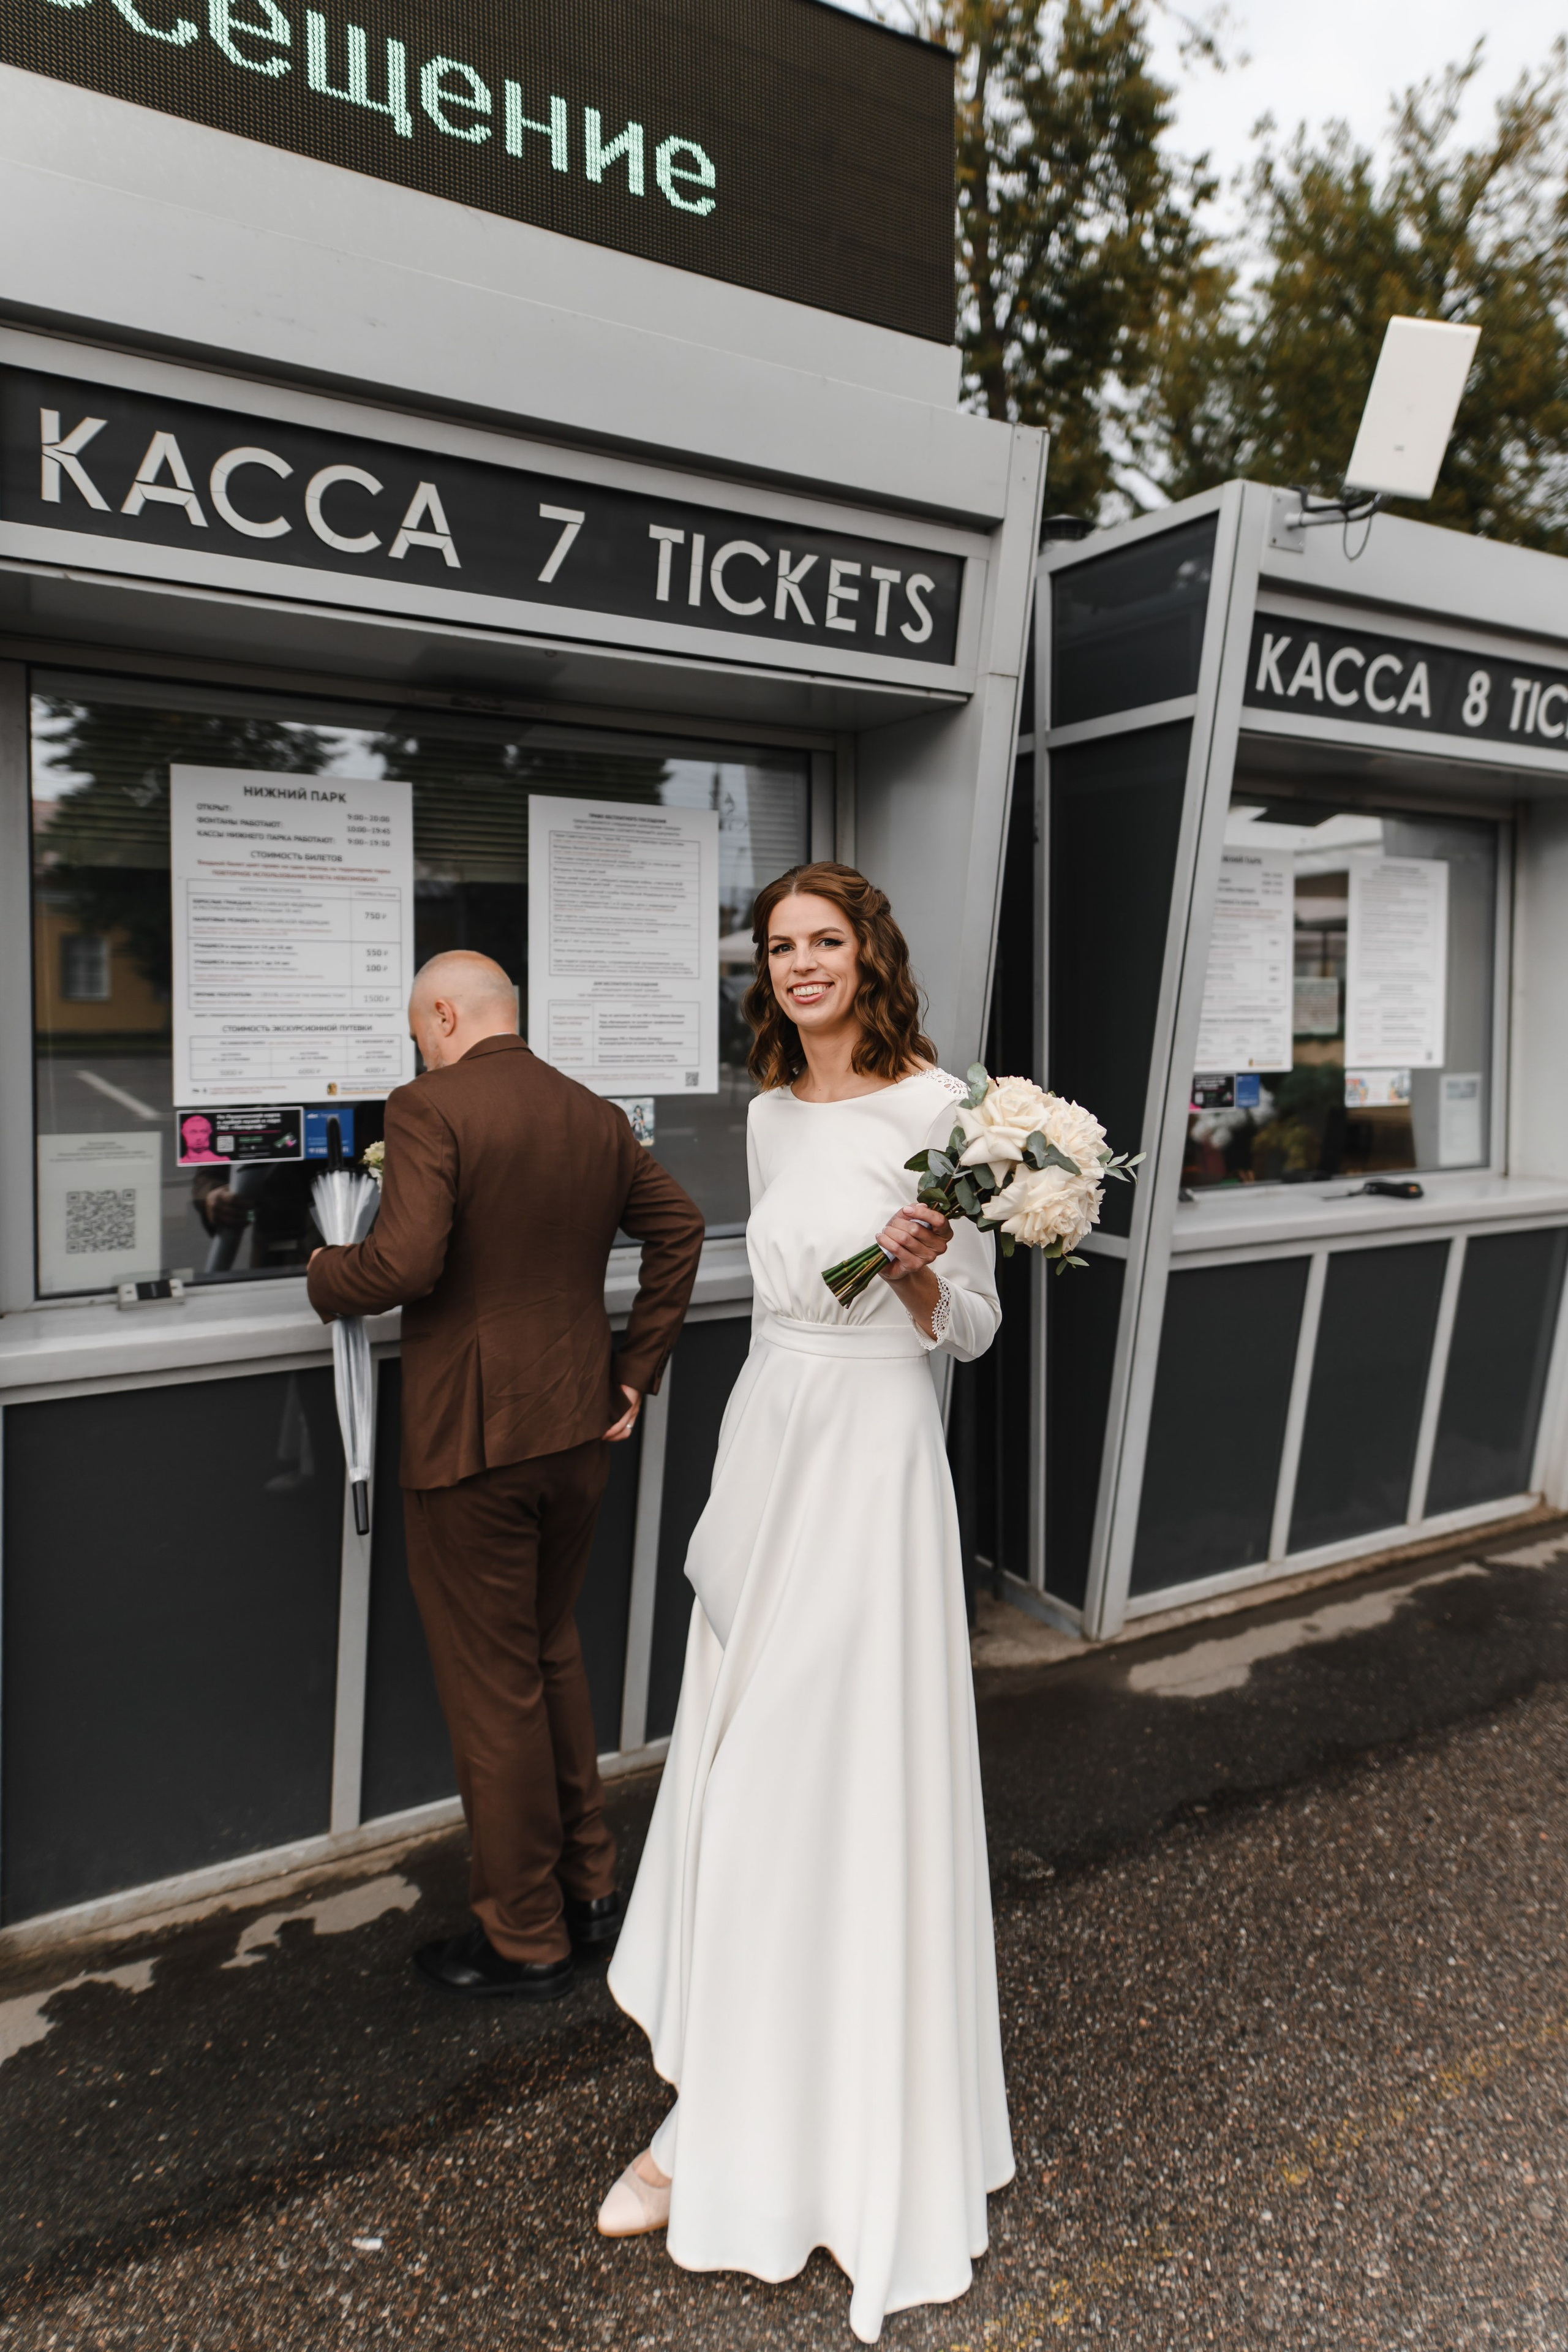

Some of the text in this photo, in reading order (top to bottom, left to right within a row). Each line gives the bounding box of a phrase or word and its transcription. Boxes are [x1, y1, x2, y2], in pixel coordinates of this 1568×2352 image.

[47, 0, 717, 216] сещение
[39, 407, 935, 643] КАССА 7 TICKETS
[1255, 633, 1568, 739] КАССА 8 TIC
[244, 786, 347, 804] НИЖНИЙ ПАРК
[251, 850, 342, 862] СТОИМОСТЬ БИЛЕТОВ
[365, 911, 380, 920] 750
[222, 1025, 270, 1033] СТОИМОСТЬ
